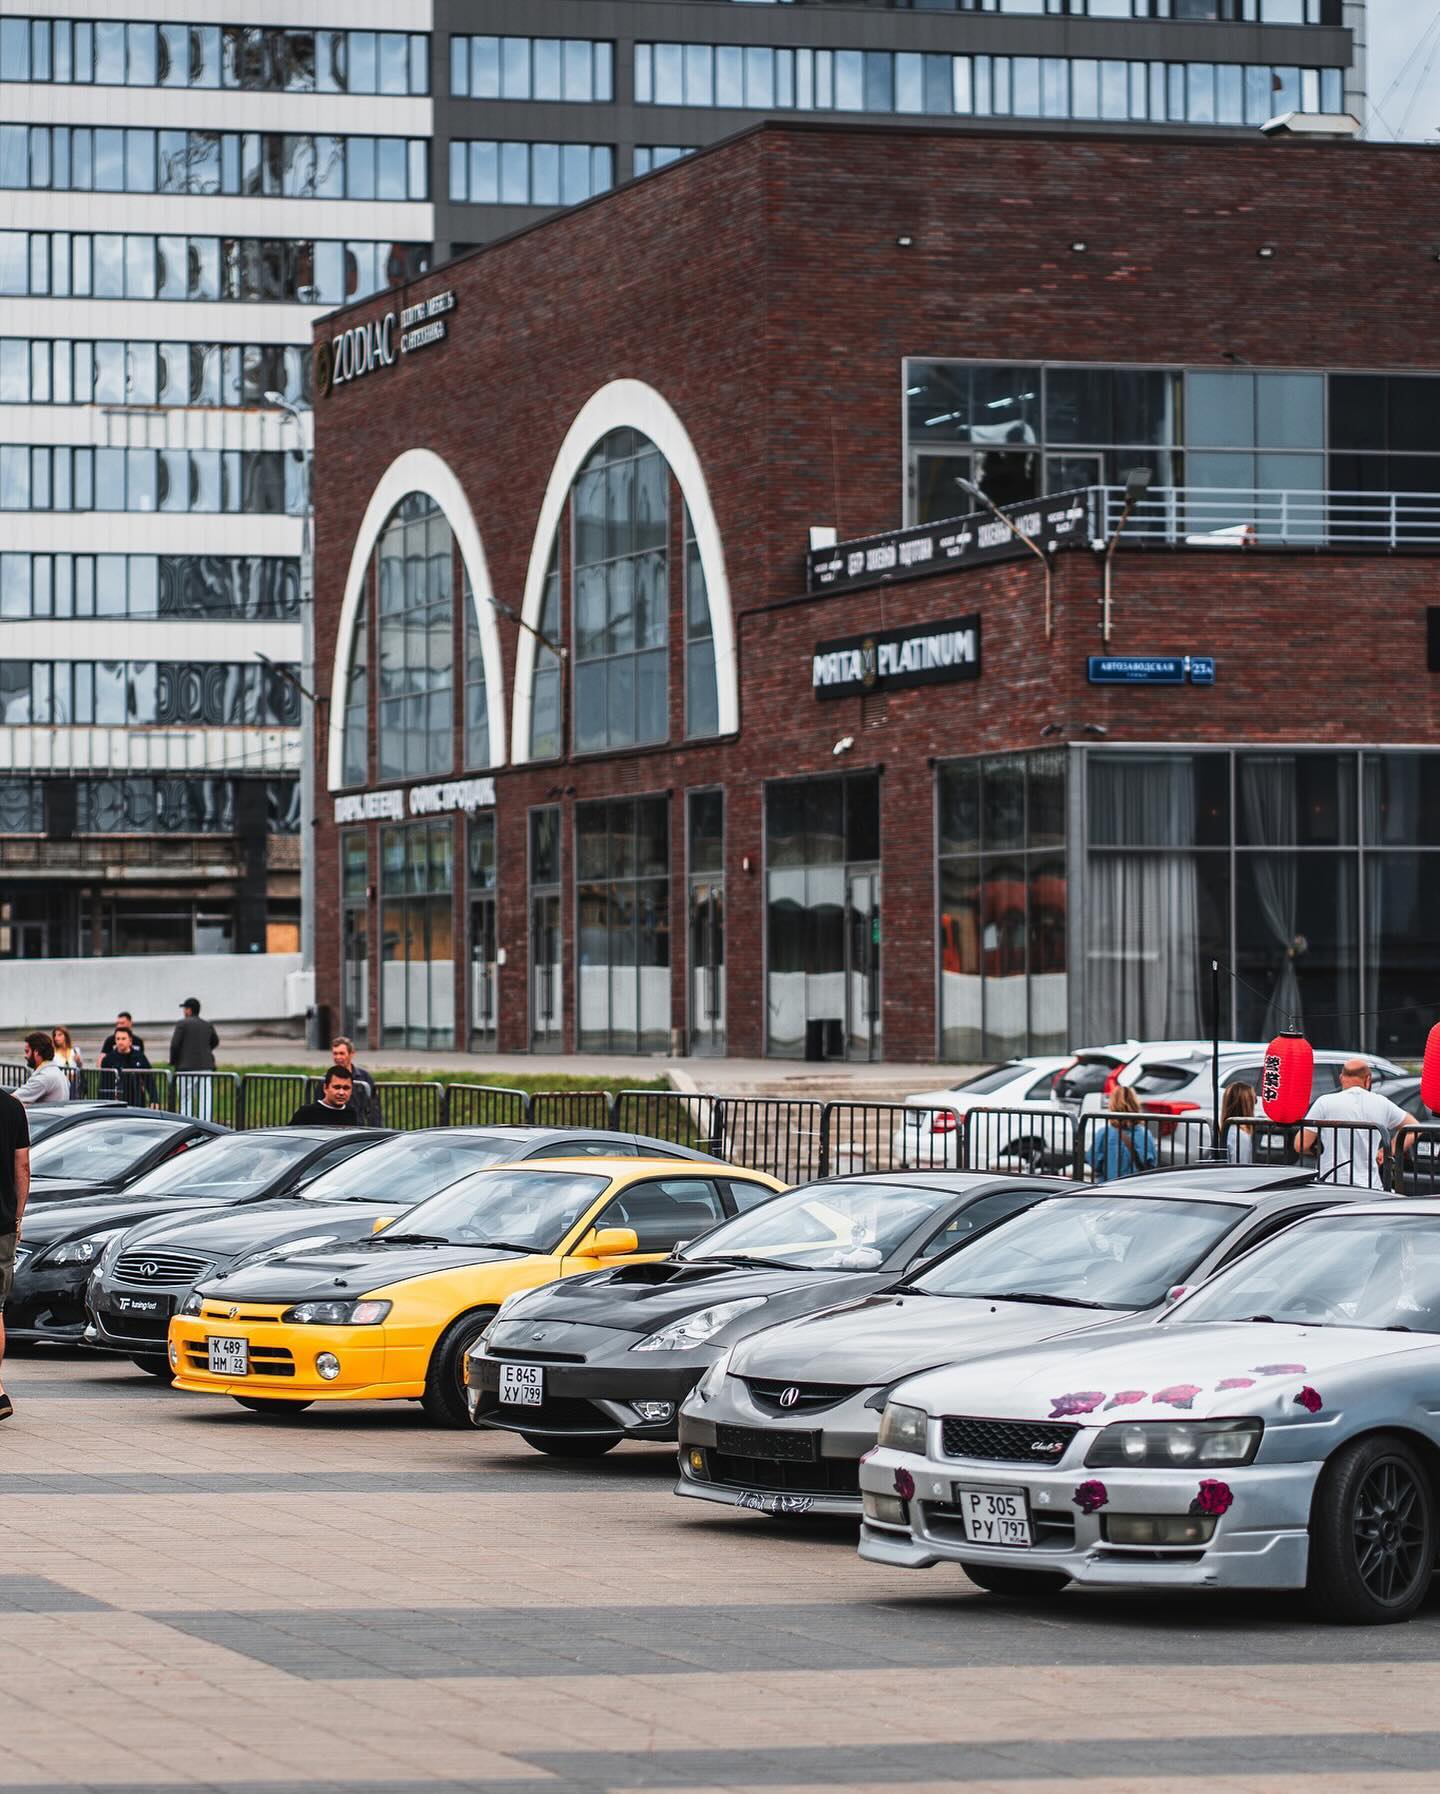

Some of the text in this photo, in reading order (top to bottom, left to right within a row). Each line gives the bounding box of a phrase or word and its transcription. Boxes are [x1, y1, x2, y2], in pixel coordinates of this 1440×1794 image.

[332, 312, 396, 384] ZODIAC
[878, 629, 975, 676] PLATINUM
[223, 1340, 240, 1355] 489
[234, 1358, 243, 1369] 22
[516, 1368, 536, 1383] 845
[524, 1386, 541, 1400] 799
[986, 1496, 1016, 1516] 305
[1001, 1521, 1025, 1537] 797
